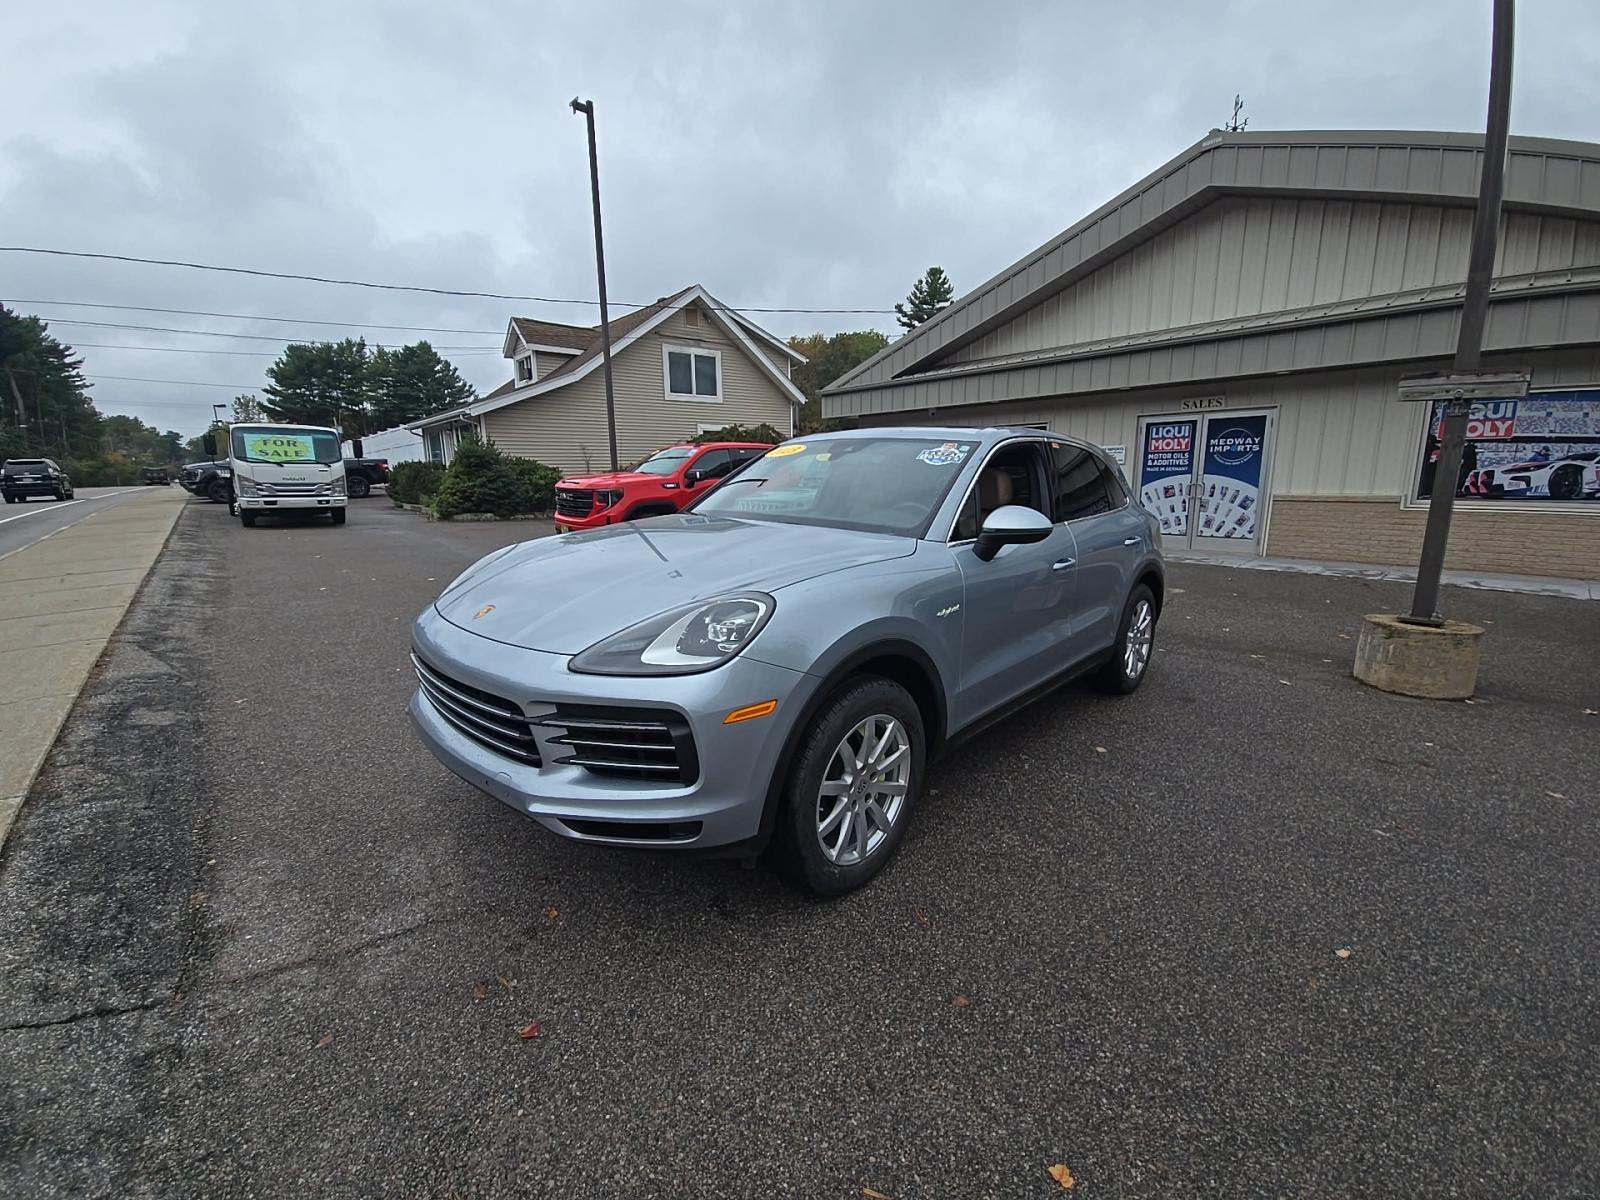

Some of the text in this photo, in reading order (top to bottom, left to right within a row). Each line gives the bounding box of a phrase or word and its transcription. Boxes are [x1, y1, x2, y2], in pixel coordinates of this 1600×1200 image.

[1183, 398, 1222, 409] SALES
[1469, 402, 1514, 419] QUI
[1151, 425, 1190, 438] LIQUI
[1466, 421, 1514, 437] OLY
[262, 439, 298, 447] FOR
[1151, 439, 1187, 450] MOLY
[1210, 437, 1261, 445] MEDWAY
[258, 449, 305, 457] SALE
